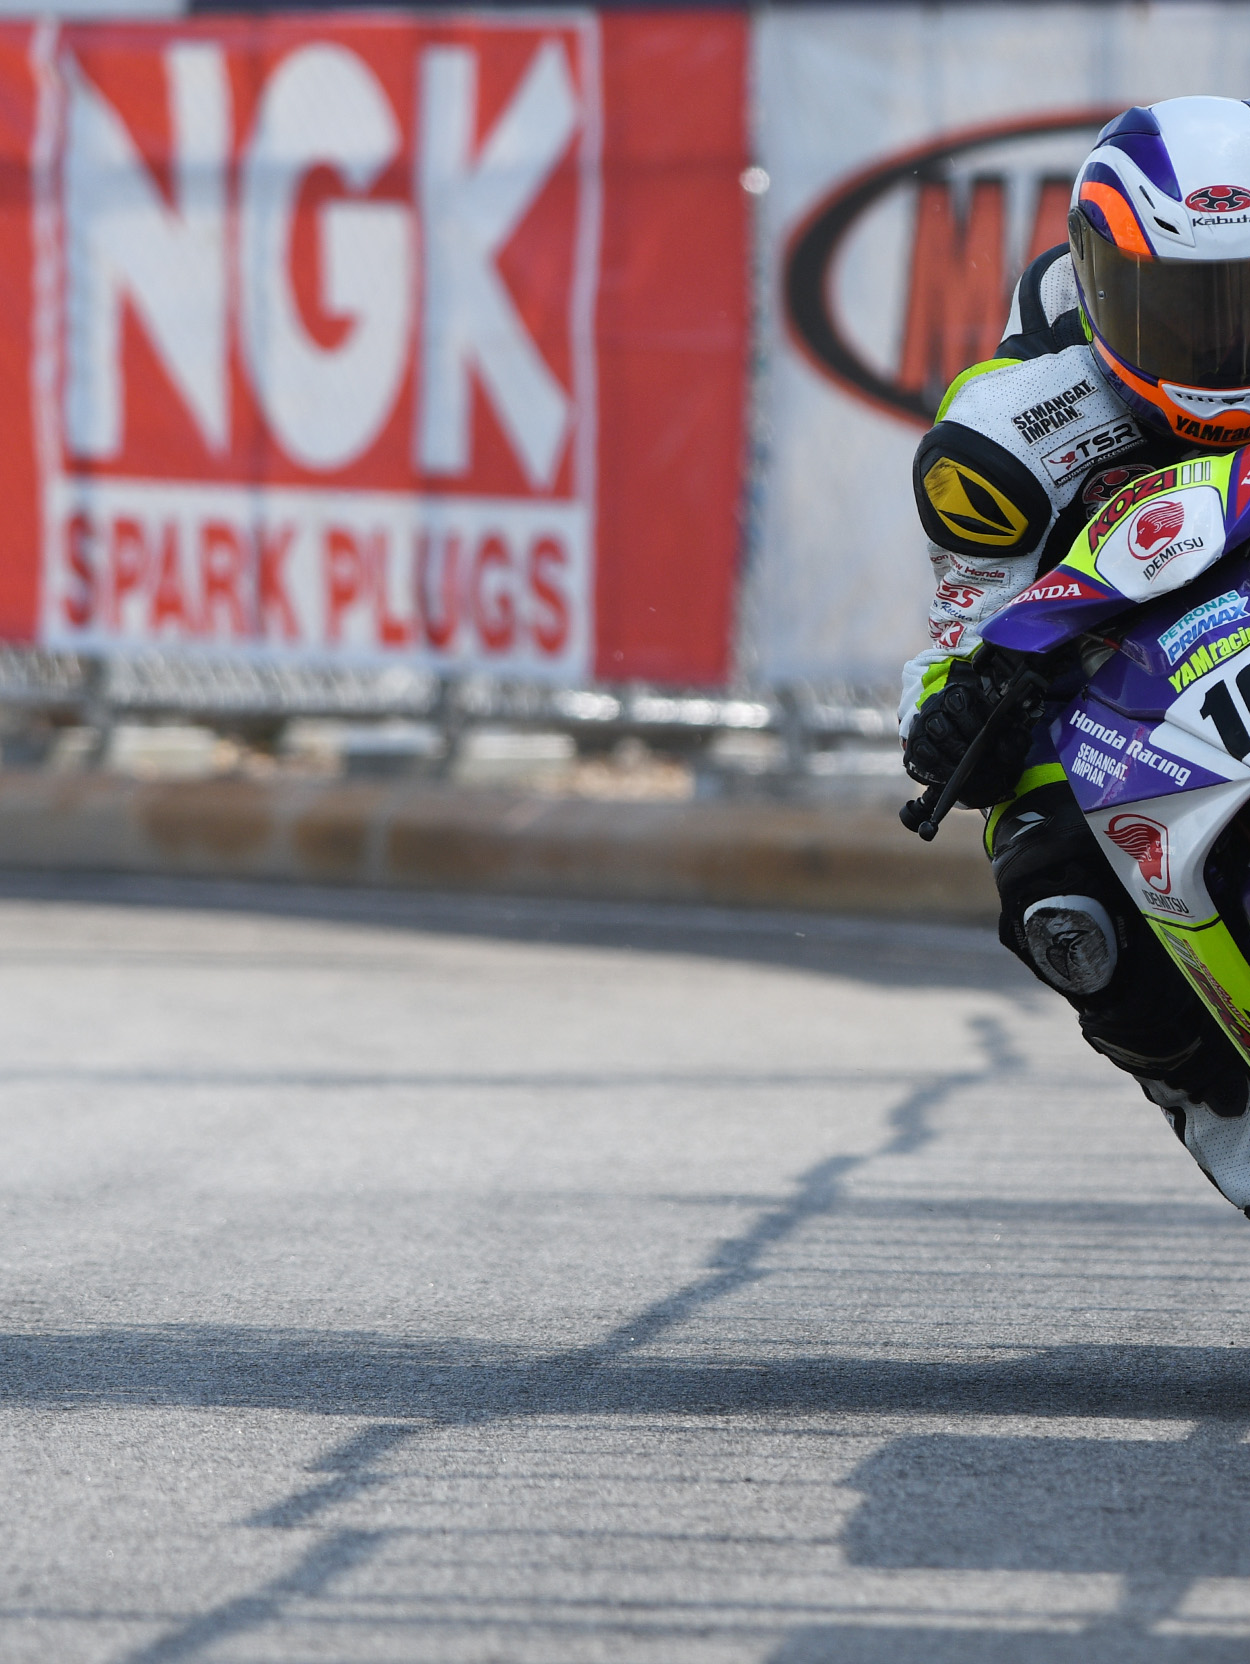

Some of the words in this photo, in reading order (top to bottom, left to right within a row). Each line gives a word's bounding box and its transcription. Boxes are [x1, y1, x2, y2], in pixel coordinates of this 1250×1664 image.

[62, 38, 579, 494] NGK
[1013, 379, 1096, 430] SEMANGAT.
[1021, 405, 1082, 445] IMPIAN.
[1076, 422, 1137, 457] TSR
[1088, 468, 1177, 556] KOZI
[964, 566, 1006, 579] Honda
[1143, 536, 1204, 581] IDEMITSU
[64, 512, 297, 650] SPARK
[324, 522, 573, 661] PLUGS
[1160, 591, 1239, 646] PETRONAS
[1168, 600, 1247, 663] PRIMAX
[1069, 709, 1127, 750] Honda
[1125, 739, 1192, 787] Racing
[1077, 742, 1128, 781] SEMANGAT.
[1071, 757, 1105, 788] IMPIAN.
[1142, 889, 1189, 914] IDEMITSU
